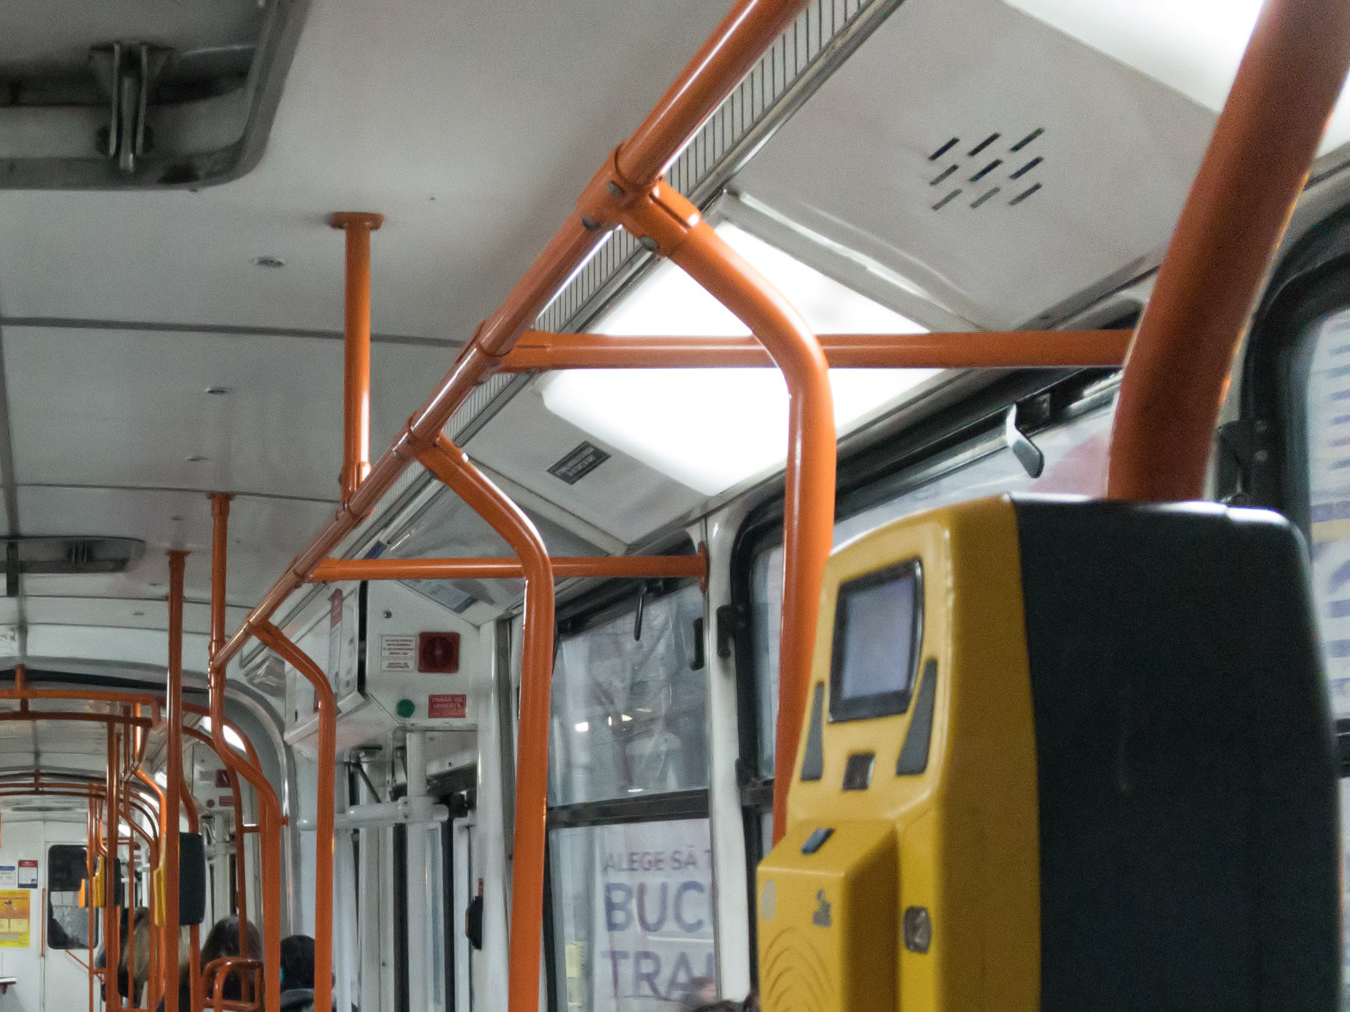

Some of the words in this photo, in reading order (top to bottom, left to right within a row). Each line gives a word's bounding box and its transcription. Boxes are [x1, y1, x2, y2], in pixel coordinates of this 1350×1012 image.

[604, 850, 665, 872] ALEGE
[671, 845, 697, 871] SĂ
[604, 880, 714, 934] BUC
